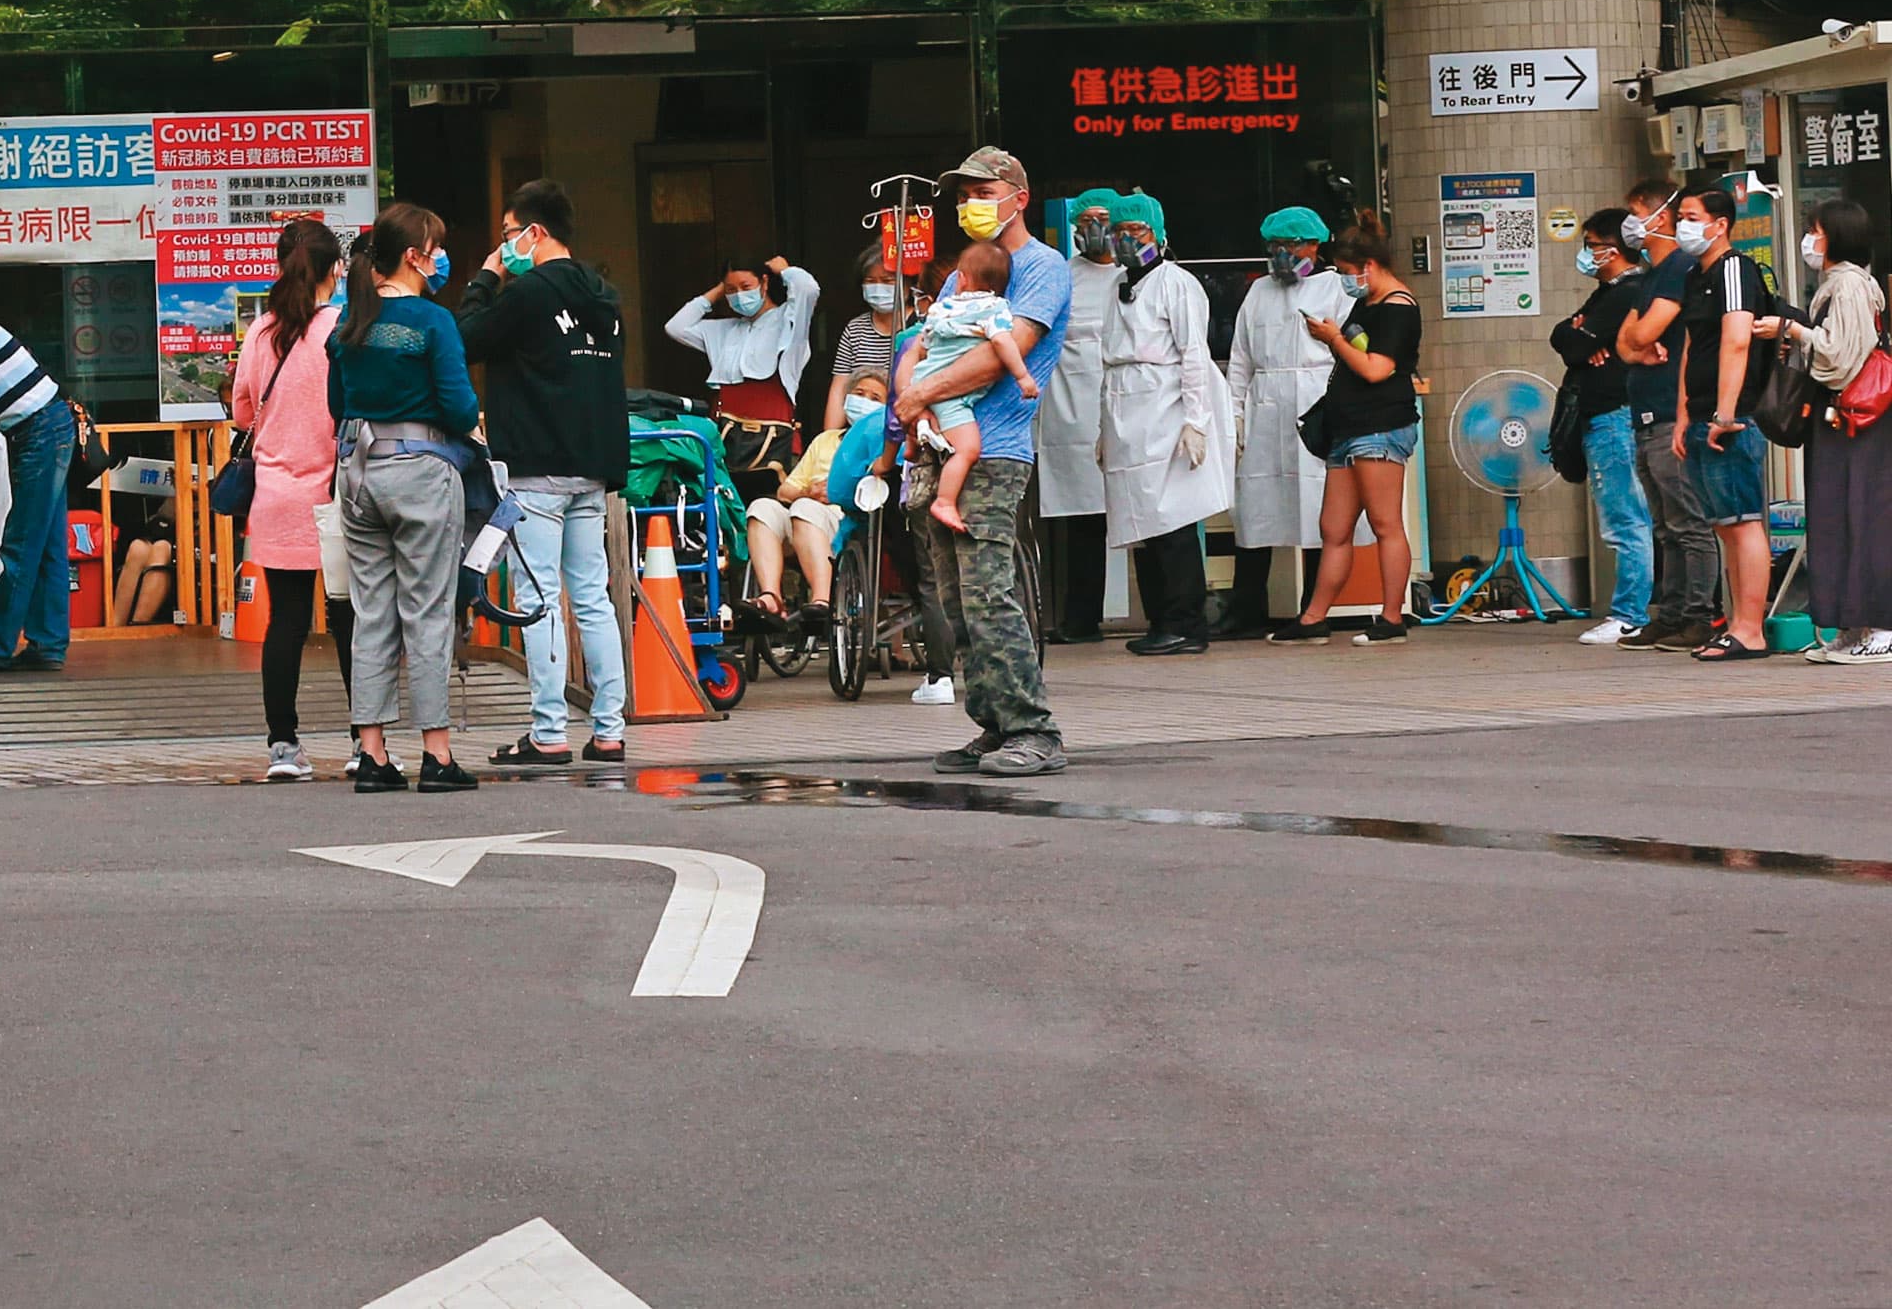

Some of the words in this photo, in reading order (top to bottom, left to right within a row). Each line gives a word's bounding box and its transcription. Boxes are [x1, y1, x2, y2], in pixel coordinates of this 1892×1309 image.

[1070, 63, 1298, 106] 僅供急診進出
[1438, 62, 1536, 92] 往後門
[1441, 97, 1456, 108] To
[1461, 96, 1493, 107] Rear
[1496, 94, 1536, 107] Entry
[159, 123, 257, 144] Covid-19
[263, 121, 307, 141] PCR
[311, 119, 364, 140] TEST
[1074, 114, 1126, 137] Only
[1132, 113, 1164, 132] for
[1171, 111, 1301, 135] Emergency
[1805, 109, 1881, 168] 警衛室
[161, 146, 365, 167] 新冠肺炎自費篩檢已預約者
